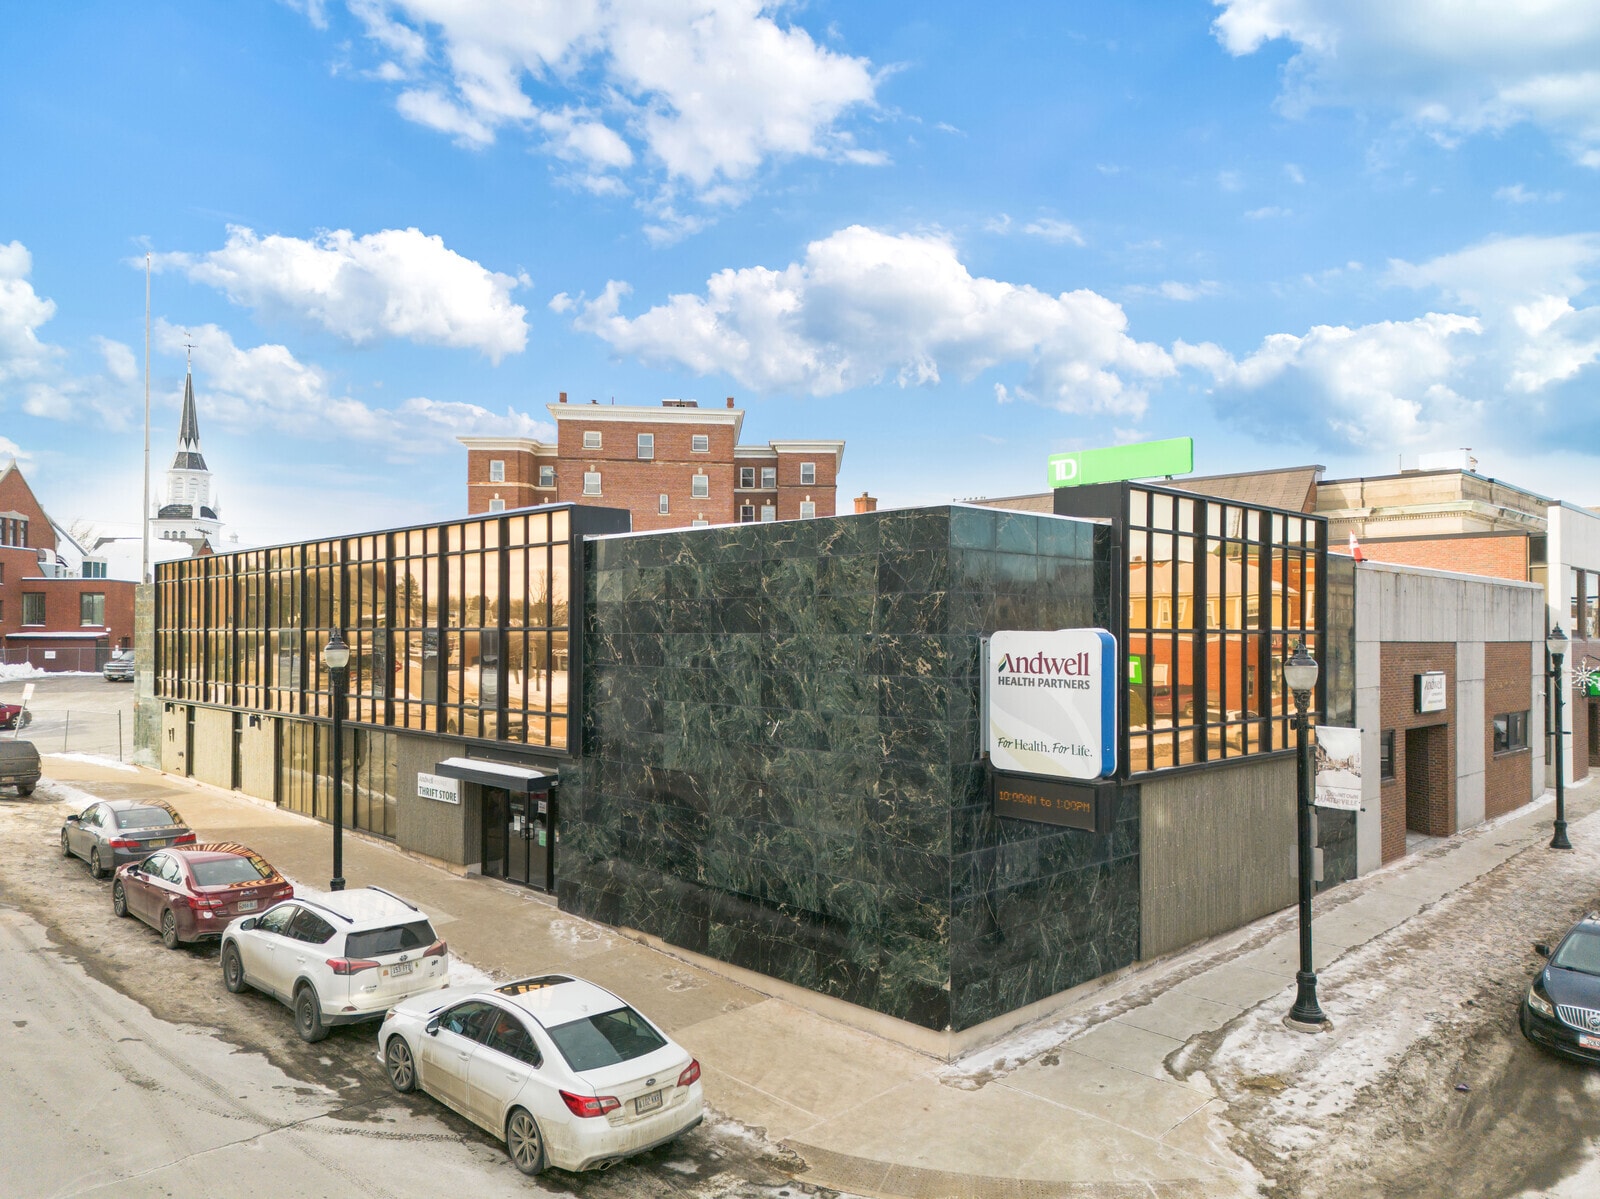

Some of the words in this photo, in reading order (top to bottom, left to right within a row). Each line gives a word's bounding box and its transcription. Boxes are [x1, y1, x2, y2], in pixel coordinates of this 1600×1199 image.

[1050, 459, 1077, 481] TD
[998, 651, 1090, 676] Andwell
[998, 676, 1035, 687] HEALTH
[1037, 678, 1090, 690] PARTNERS
[998, 737, 1013, 748] For
[1014, 739, 1050, 753] Health.
[1052, 742, 1069, 754] For
[1071, 744, 1093, 757] Life.
[419, 786, 438, 798] THRIFT
[439, 790, 457, 802] STORE
[1040, 797, 1052, 807] to
